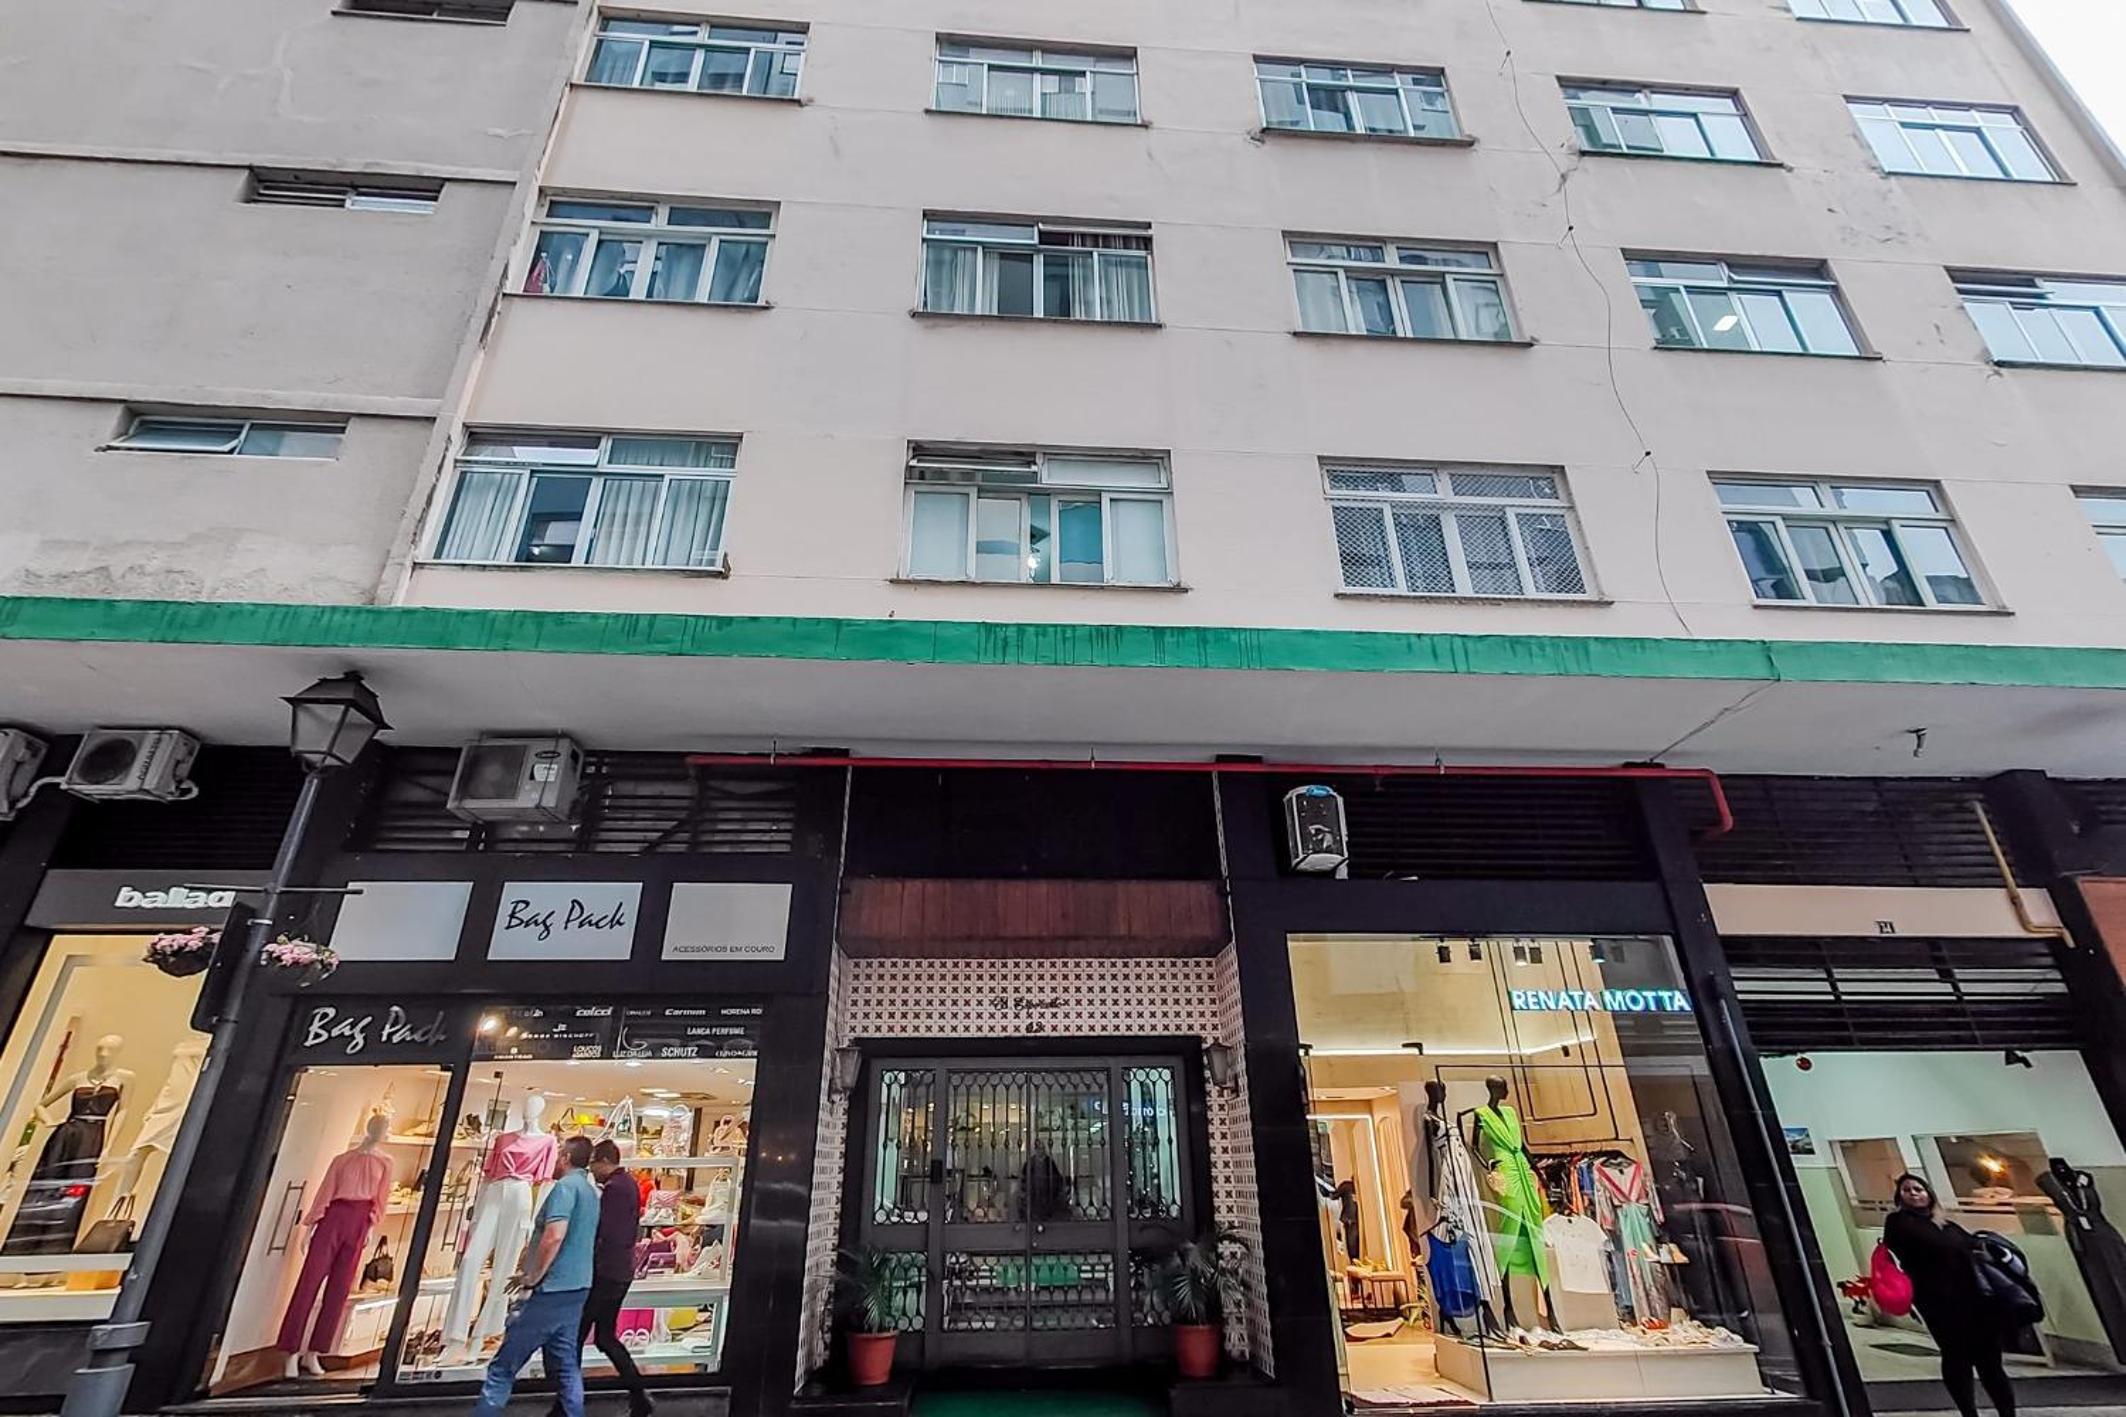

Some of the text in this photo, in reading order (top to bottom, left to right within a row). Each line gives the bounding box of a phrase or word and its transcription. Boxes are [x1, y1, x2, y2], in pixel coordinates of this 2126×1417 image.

[504, 898, 626, 941] Bag Pack
[729, 945, 743, 953] EM
[744, 945, 775, 953] COURO
[1510, 990, 1692, 1012] RENATA MOTTA
[303, 1004, 447, 1055] Bag Pack
[661, 1047, 699, 1057] SCHUTZ
